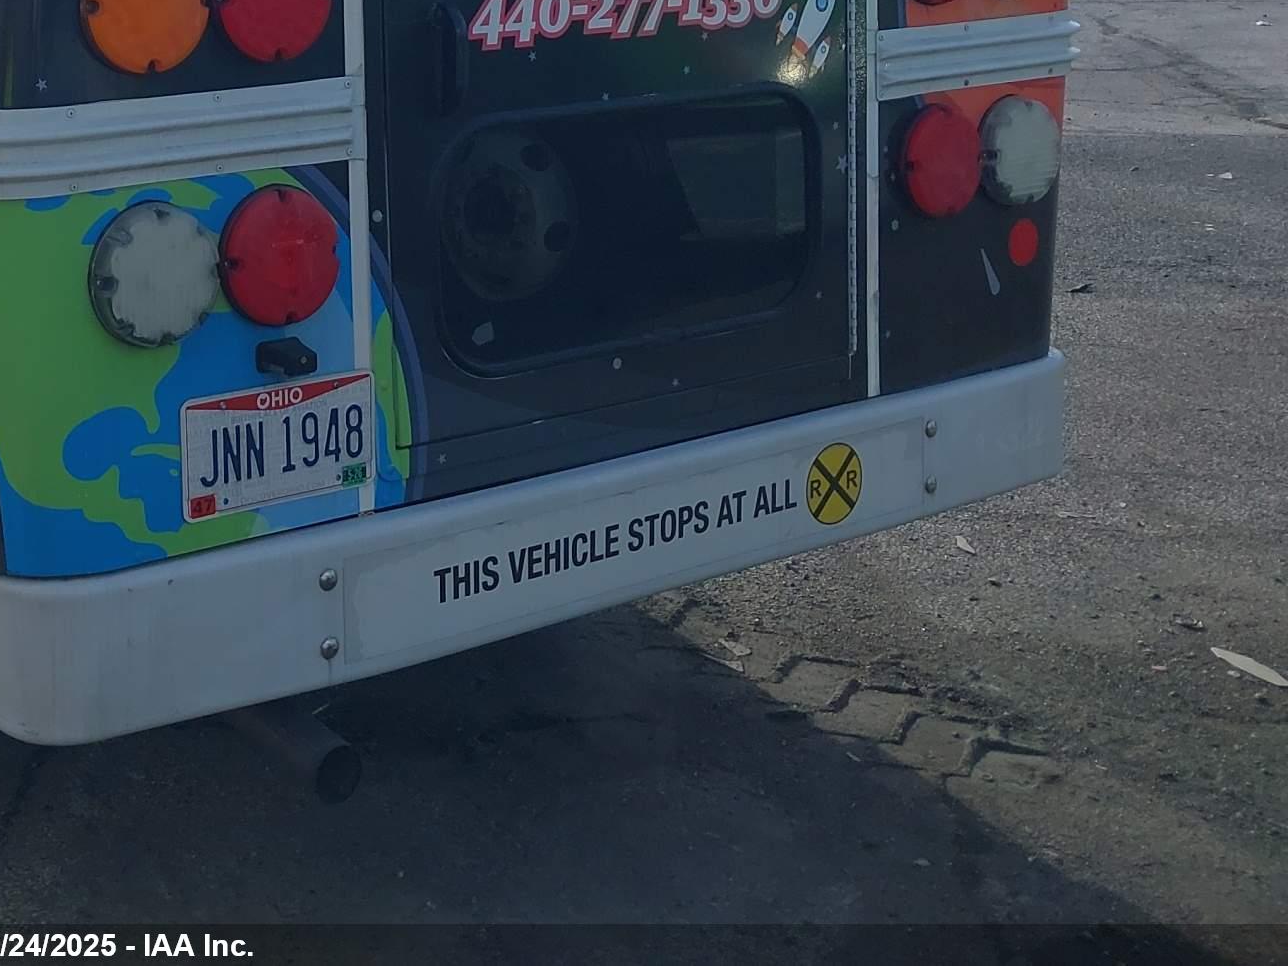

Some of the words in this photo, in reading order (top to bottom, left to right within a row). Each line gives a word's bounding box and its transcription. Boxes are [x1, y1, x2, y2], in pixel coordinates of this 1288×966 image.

[257, 387, 303, 410] OHIO
[200, 421, 265, 488] JNN
[282, 404, 363, 473] 1948
[434, 555, 500, 604] THIS
[509, 523, 620, 584] VEHICLE
[628, 500, 710, 552] STOPS
[717, 490, 748, 528] AT
[753, 479, 798, 518] ALL
